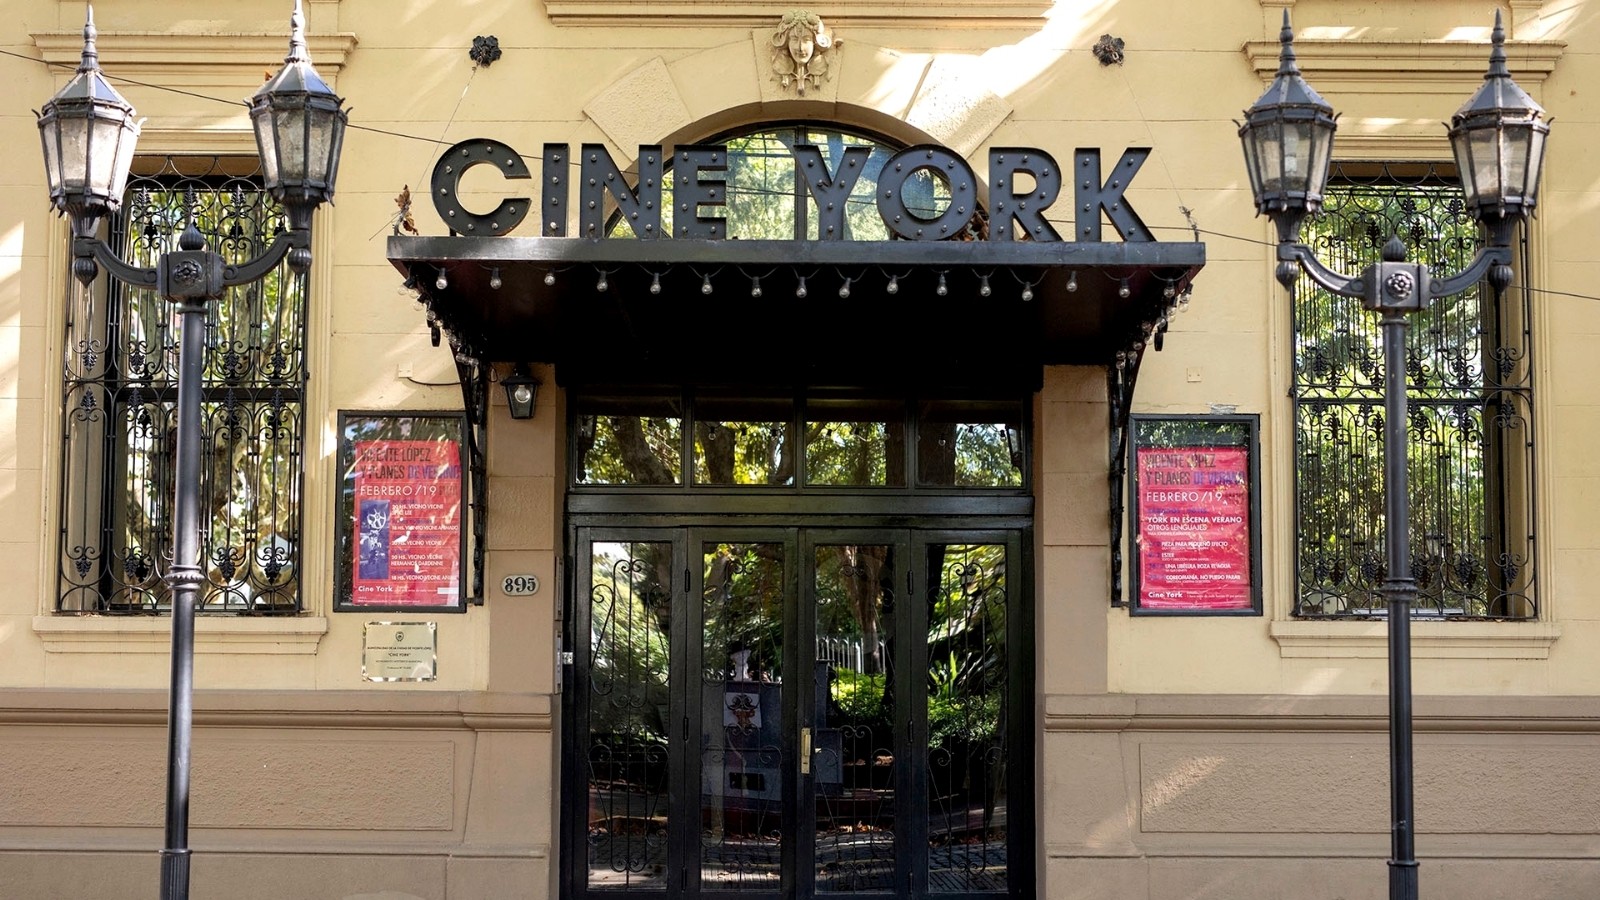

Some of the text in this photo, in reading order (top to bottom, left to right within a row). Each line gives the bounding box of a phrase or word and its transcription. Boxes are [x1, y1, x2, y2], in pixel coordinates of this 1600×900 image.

[431, 138, 1154, 242] CINE YORK
[402, 445, 431, 461] LÓPEZ
[1145, 454, 1184, 468] VICENTE
[408, 465, 419, 479] DE
[1146, 471, 1152, 485] Y
[1154, 471, 1190, 485] PLANES
[1193, 471, 1204, 485] DE
[360, 485, 412, 496] FEBRERO
[415, 485, 437, 496] /19
[1146, 491, 1199, 502] FEBRERO
[1201, 491, 1222, 502] /19
[505, 576, 536, 593] 895
